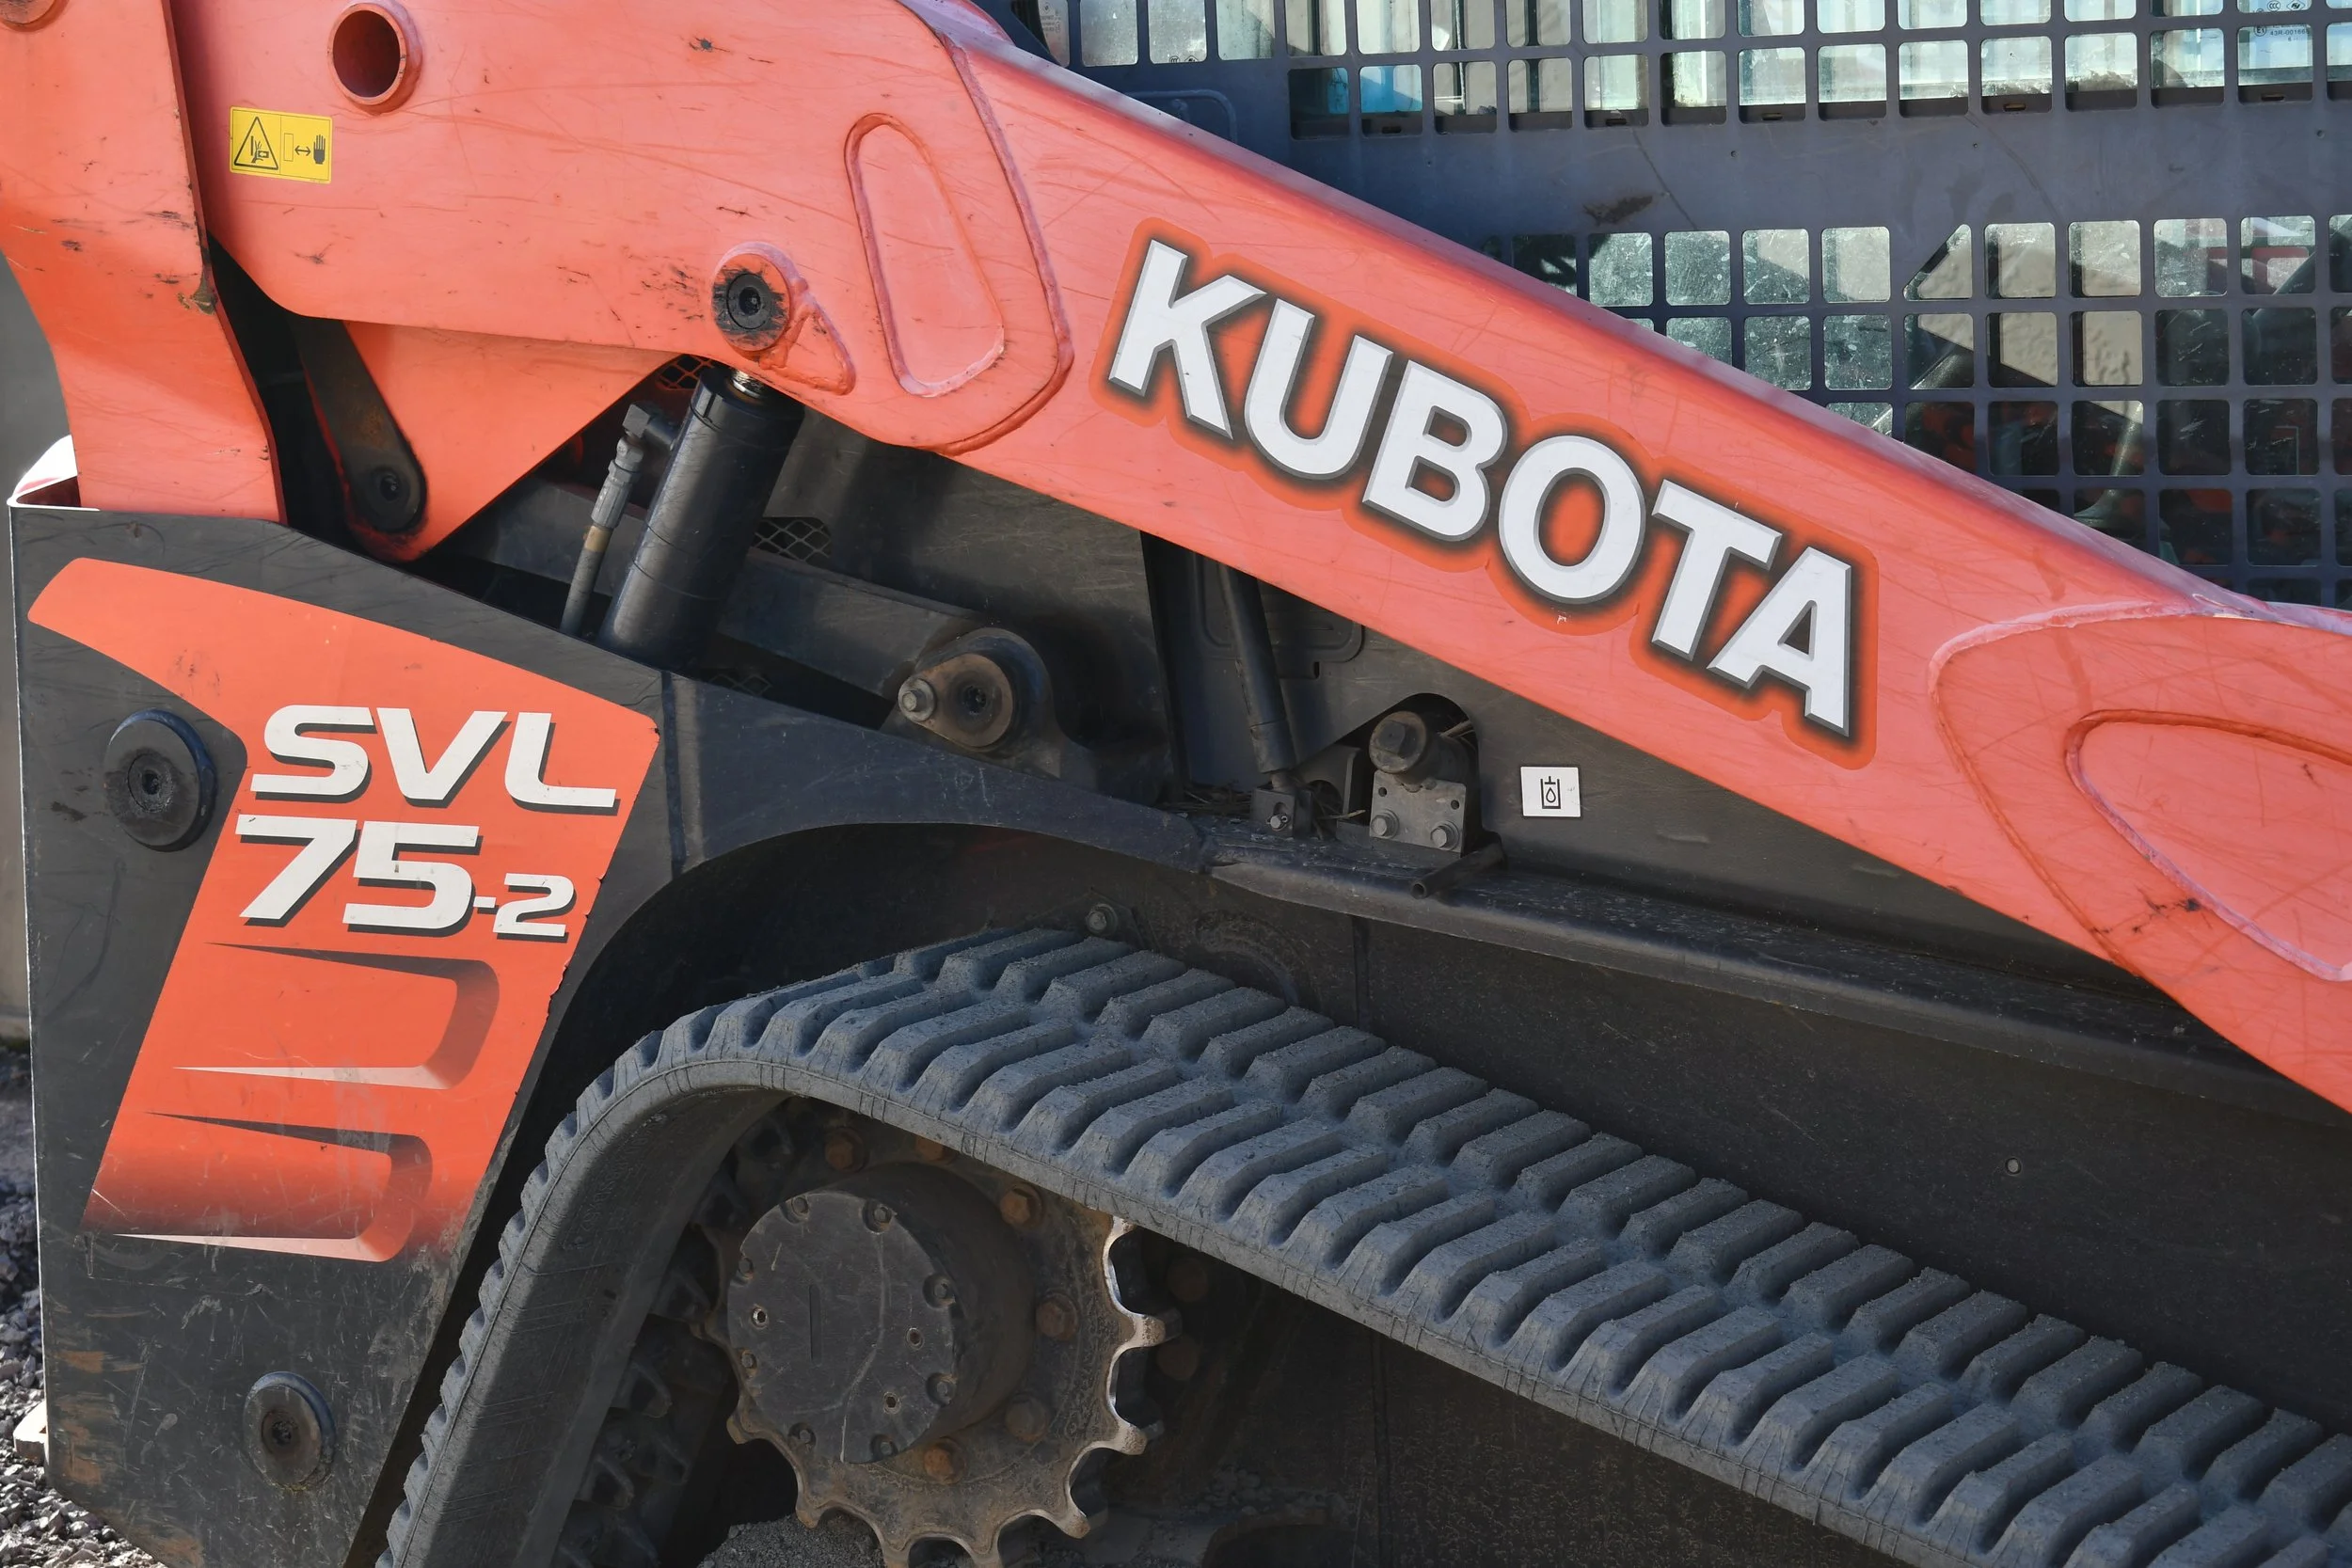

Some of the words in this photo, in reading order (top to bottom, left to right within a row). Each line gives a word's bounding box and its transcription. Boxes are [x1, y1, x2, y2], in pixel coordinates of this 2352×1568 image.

[1108, 239, 1852, 738] KUBOTA
[249, 704, 620, 815] SVL
[235, 814, 576, 941] 75-2
